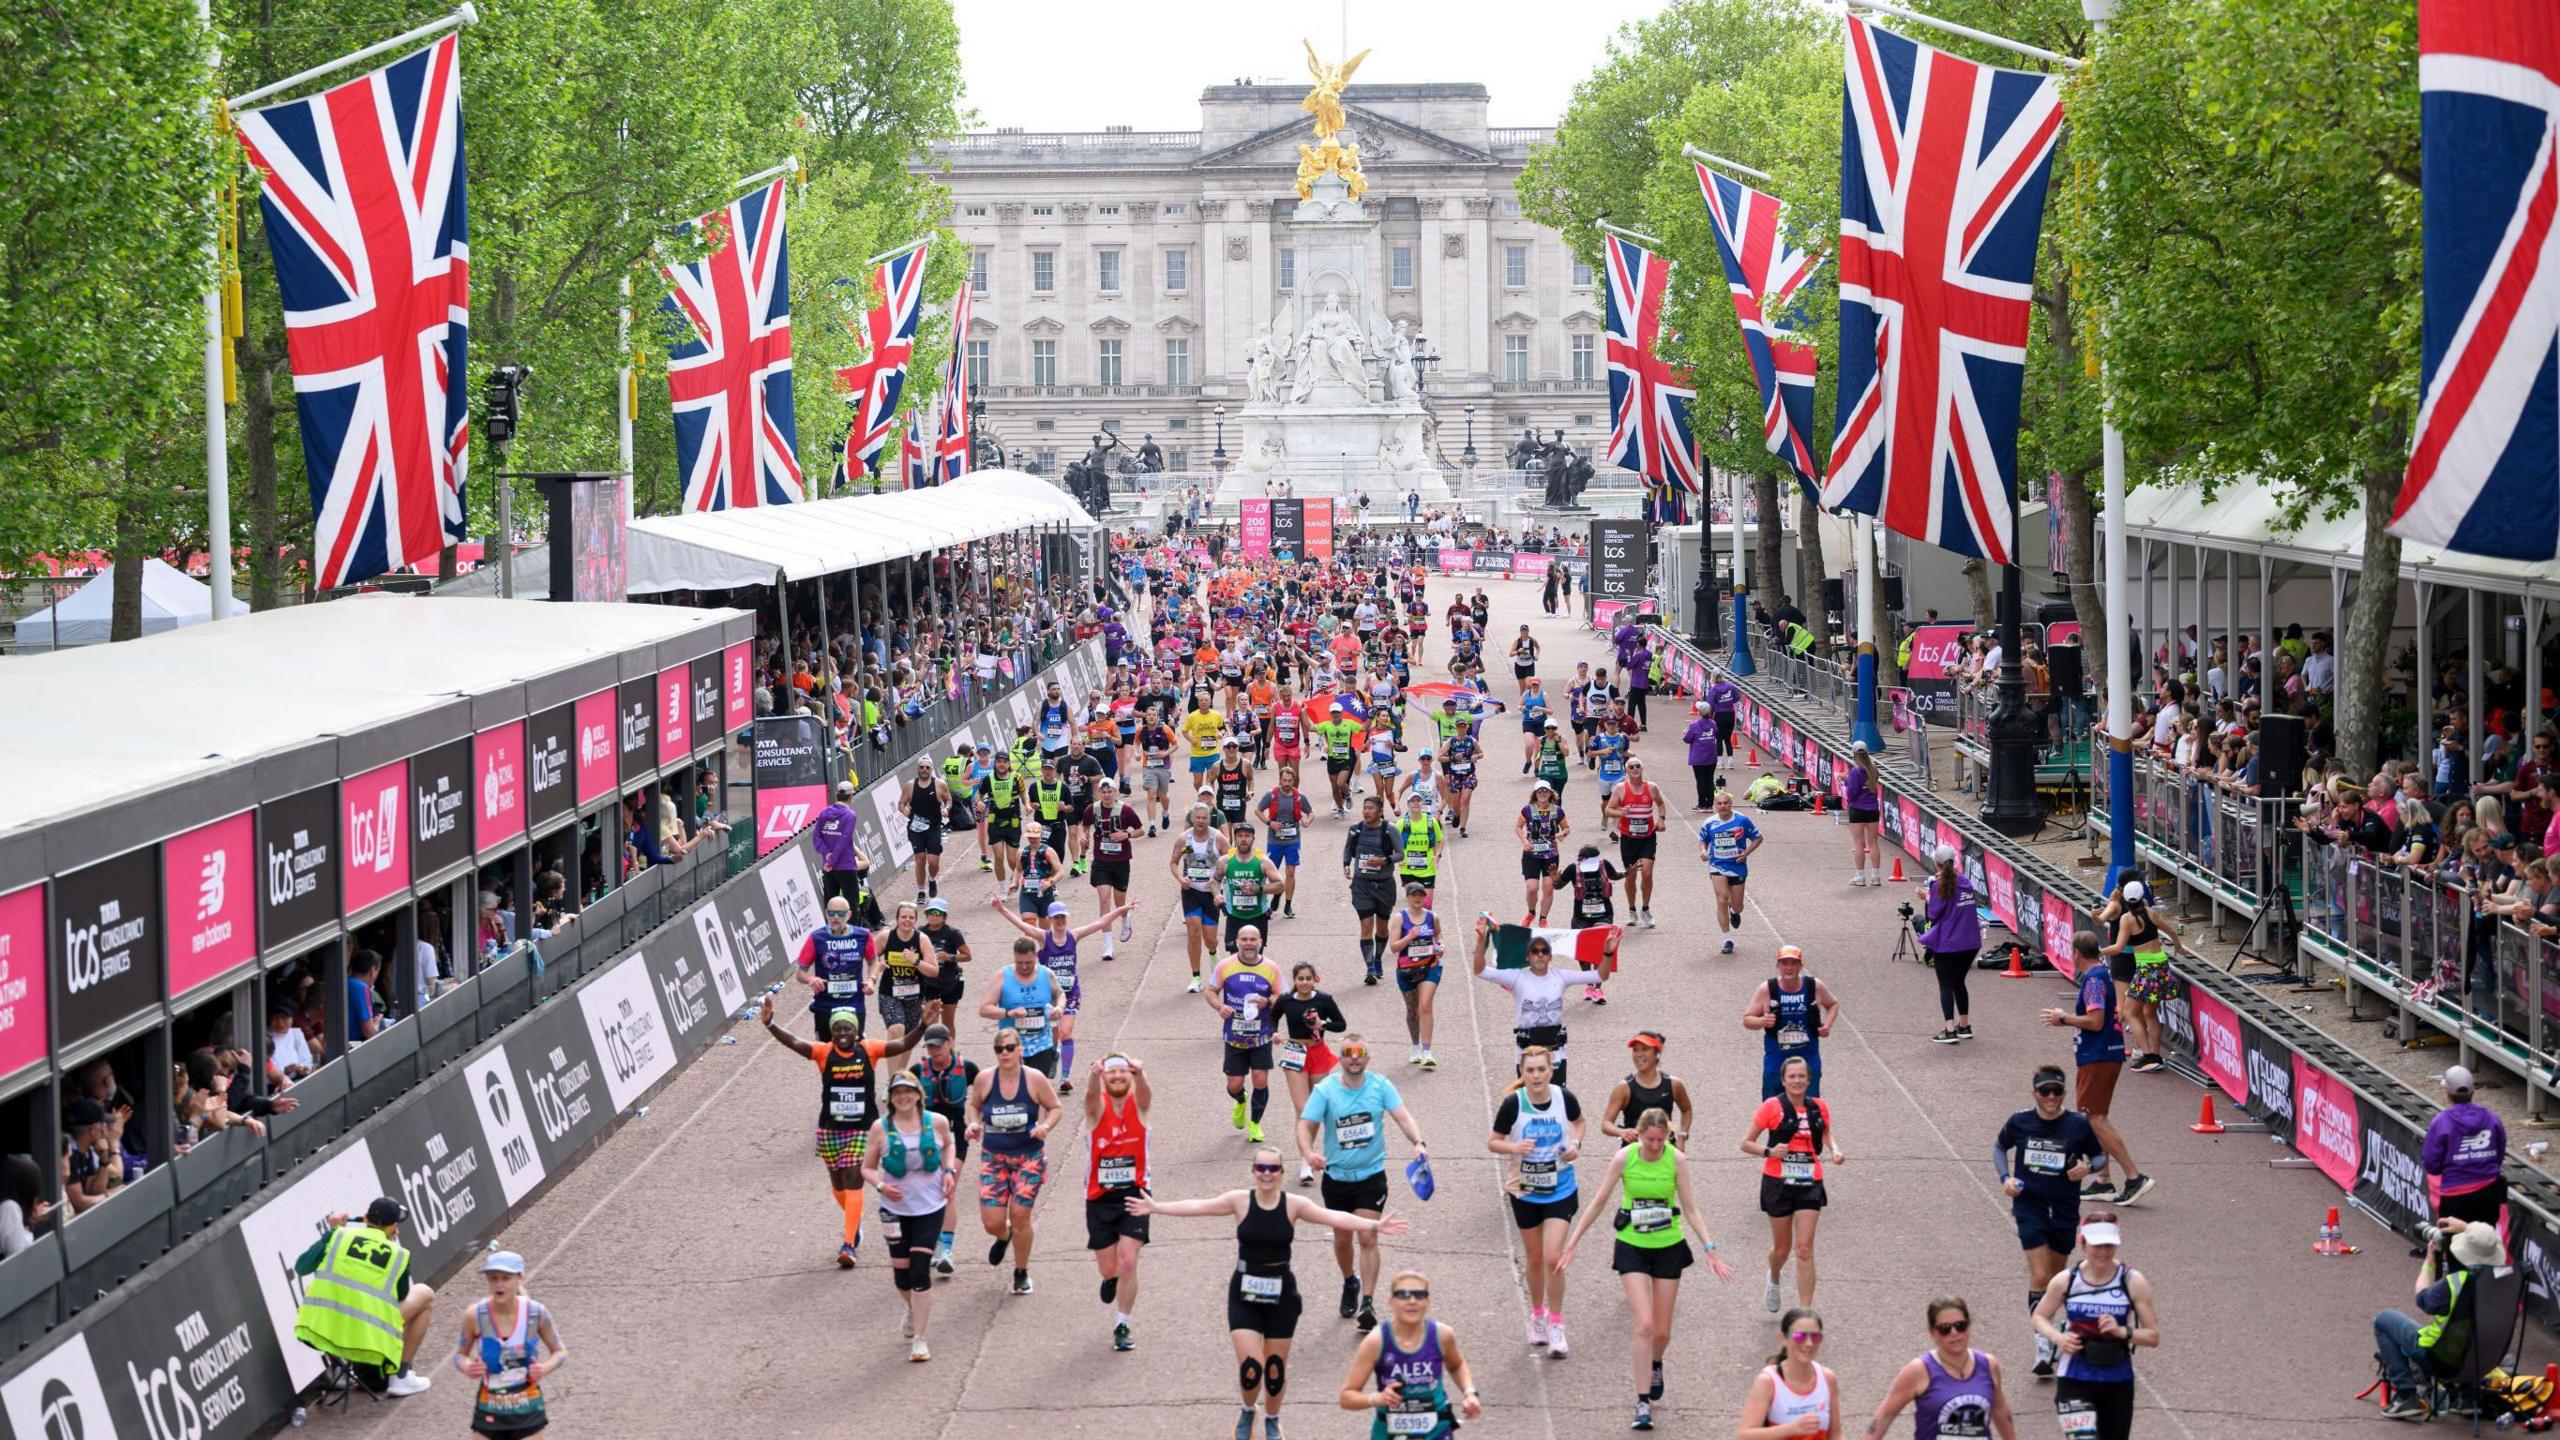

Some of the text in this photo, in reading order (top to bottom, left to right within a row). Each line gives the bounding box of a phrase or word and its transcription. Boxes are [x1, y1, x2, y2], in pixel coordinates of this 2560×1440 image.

[1246, 517, 1266, 526] 200
[1275, 517, 1293, 528] tcs
[1604, 545, 1625, 558] tcs
[1604, 579, 1625, 593] tcs
[1918, 643, 1939, 663] tcs
[695, 682, 706, 723] tcs
[623, 709, 635, 753] tcs
[756, 739, 778, 748] ATA
[756, 746, 812, 758] ONSULTANCY
[756, 757, 792, 768] ERVICES
[498, 765, 515, 785] ROYAL
[533, 744, 548, 793] tcs
[1222, 773, 1238, 781] LDN
[994, 782, 1010, 791] GUIDE
[1042, 793, 1058, 802] BLIND
[419, 786, 438, 842] tcs
[498, 790, 515, 812] PARKS
[293, 830, 309, 850] TATA
[351, 802, 375, 868] tcs
[294, 845, 327, 873] CONSULTANCY
[269, 842, 295, 907] tcs
[294, 872, 316, 897] SERVICES
[100, 900, 120, 926] TATA
[775, 891, 802, 942] tcs
[101, 916, 145, 951] CONSULTANCY
[192, 920, 232, 954] new balance
[826, 938, 858, 951] TOMMO
[66, 918, 100, 994] tcs
[730, 921, 760, 977] tcs
[102, 950, 131, 981] SERVICES
[892, 966, 916, 977] LUCY
[1239, 974, 1256, 982] MATT
[659, 973, 693, 1035] tcs
[549, 1046, 568, 1072] TATA
[599, 1017, 636, 1084] tcs
[558, 1060, 591, 1098] CONSULTANCY
[526, 1069, 570, 1142] tcs
[567, 1093, 591, 1125] SERVICES
[838, 1092, 855, 1103] Titi
[425, 1132, 449, 1163] TATA
[501, 1134, 531, 1177] TATA
[2028, 1139, 2042, 1149] tcs
[2470, 1150, 2496, 1159] balance
[436, 1146, 478, 1194] CONSULTANCY
[1104, 1170, 1130, 1180] 41854
[1522, 1163, 1536, 1173] tcs
[396, 1163, 448, 1248] tcs
[445, 1186, 476, 1225] SERVICES
[174, 1310, 210, 1352] TATA
[1391, 1361, 1434, 1377] ALEX
[127, 1356, 202, 1440] tcs
[201, 1375, 246, 1431] SERVICES
[1394, 1415, 1430, 1430] 65395
[1940, 1425, 1960, 1435] tcs
